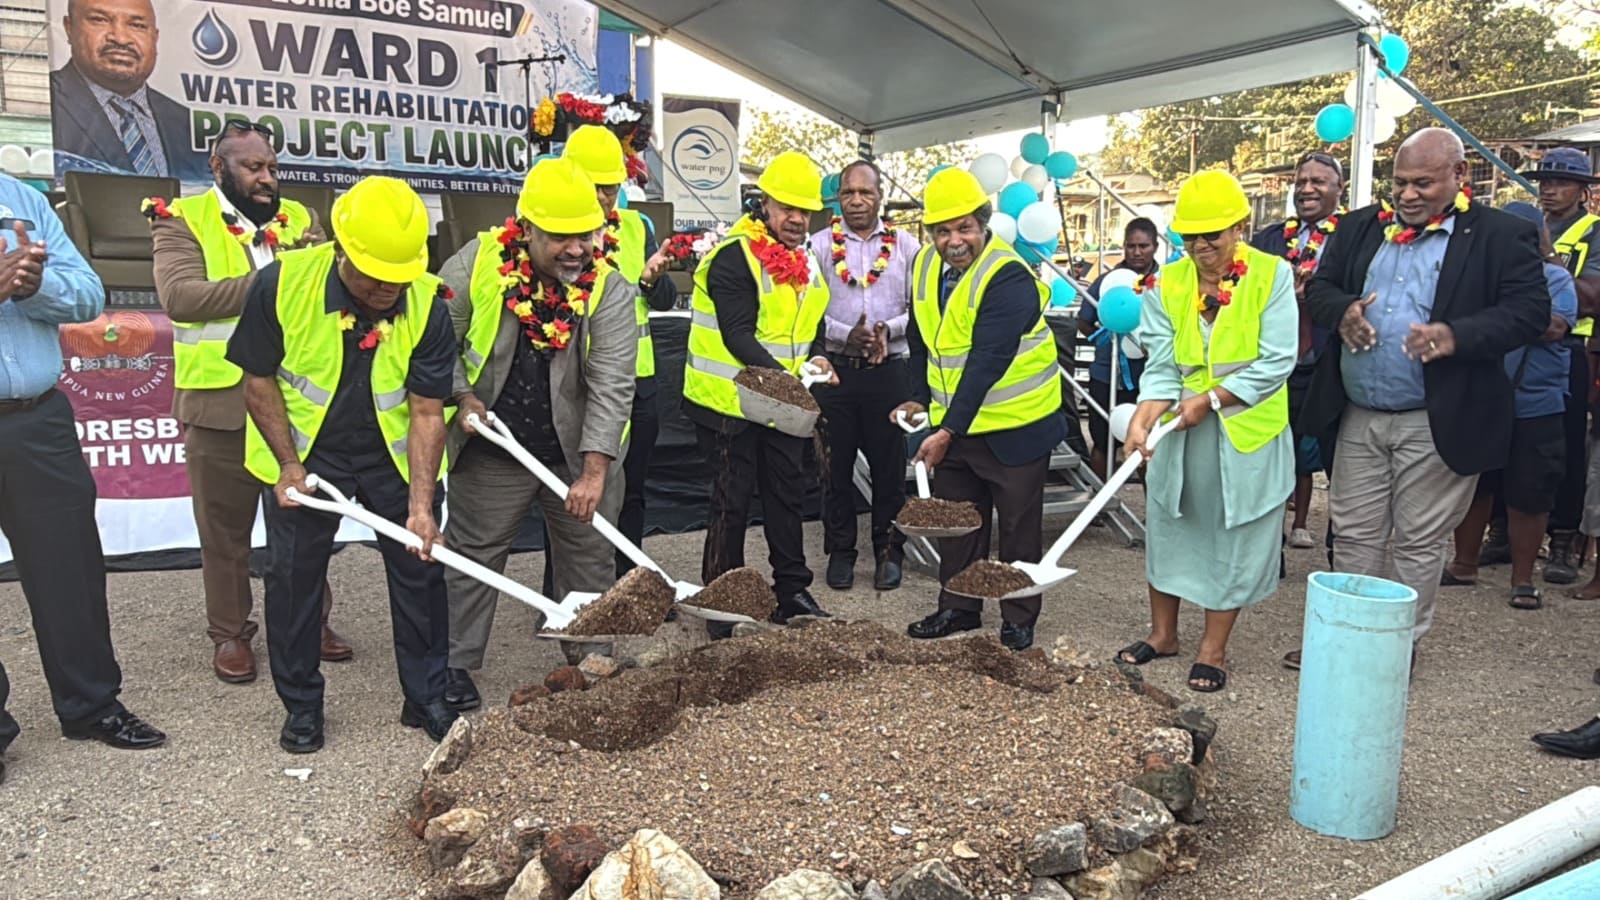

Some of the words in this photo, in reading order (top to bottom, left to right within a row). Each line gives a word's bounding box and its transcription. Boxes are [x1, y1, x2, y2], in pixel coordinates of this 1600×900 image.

[359, 0, 411, 18] Boe
[418, 0, 512, 31] Samuel
[248, 19, 459, 87] WARD
[475, 47, 498, 93] 1
[180, 73, 297, 110] WATER
[310, 84, 534, 131] REHABILITATIO
[403, 126, 526, 173] LAUNC
[276, 170, 321, 182] WATER.
[450, 180, 490, 192] BETTER
[681, 164, 706, 172] water
[709, 165, 726, 176] png
[675, 218, 695, 228] OUR
[95, 391, 126, 401] NEW
[131, 363, 168, 398] GUINEA
